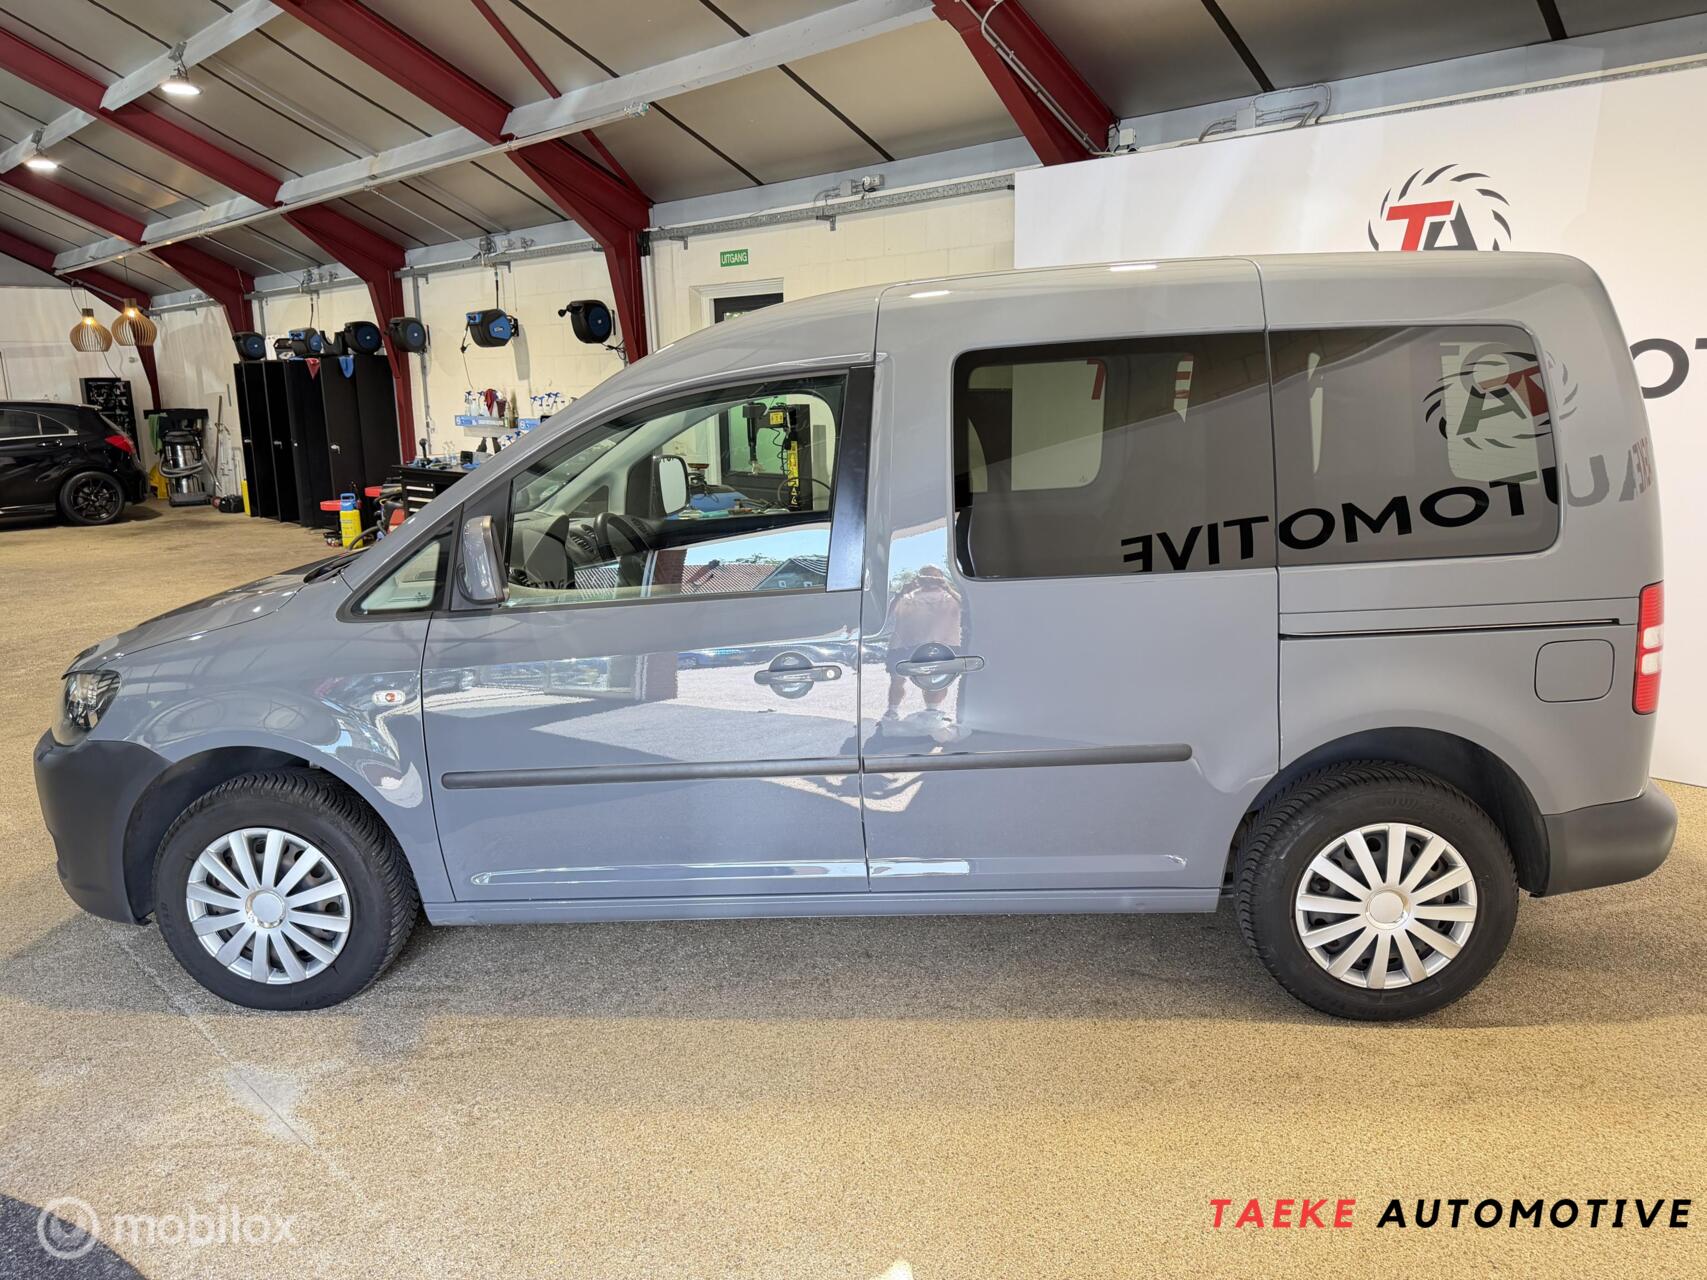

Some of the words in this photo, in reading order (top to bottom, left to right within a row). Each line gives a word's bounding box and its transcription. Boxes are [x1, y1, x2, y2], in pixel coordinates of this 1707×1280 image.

[1386, 200, 1479, 251] TA
[721, 252, 748, 265] UITGANG
[1629, 337, 1707, 400] O
